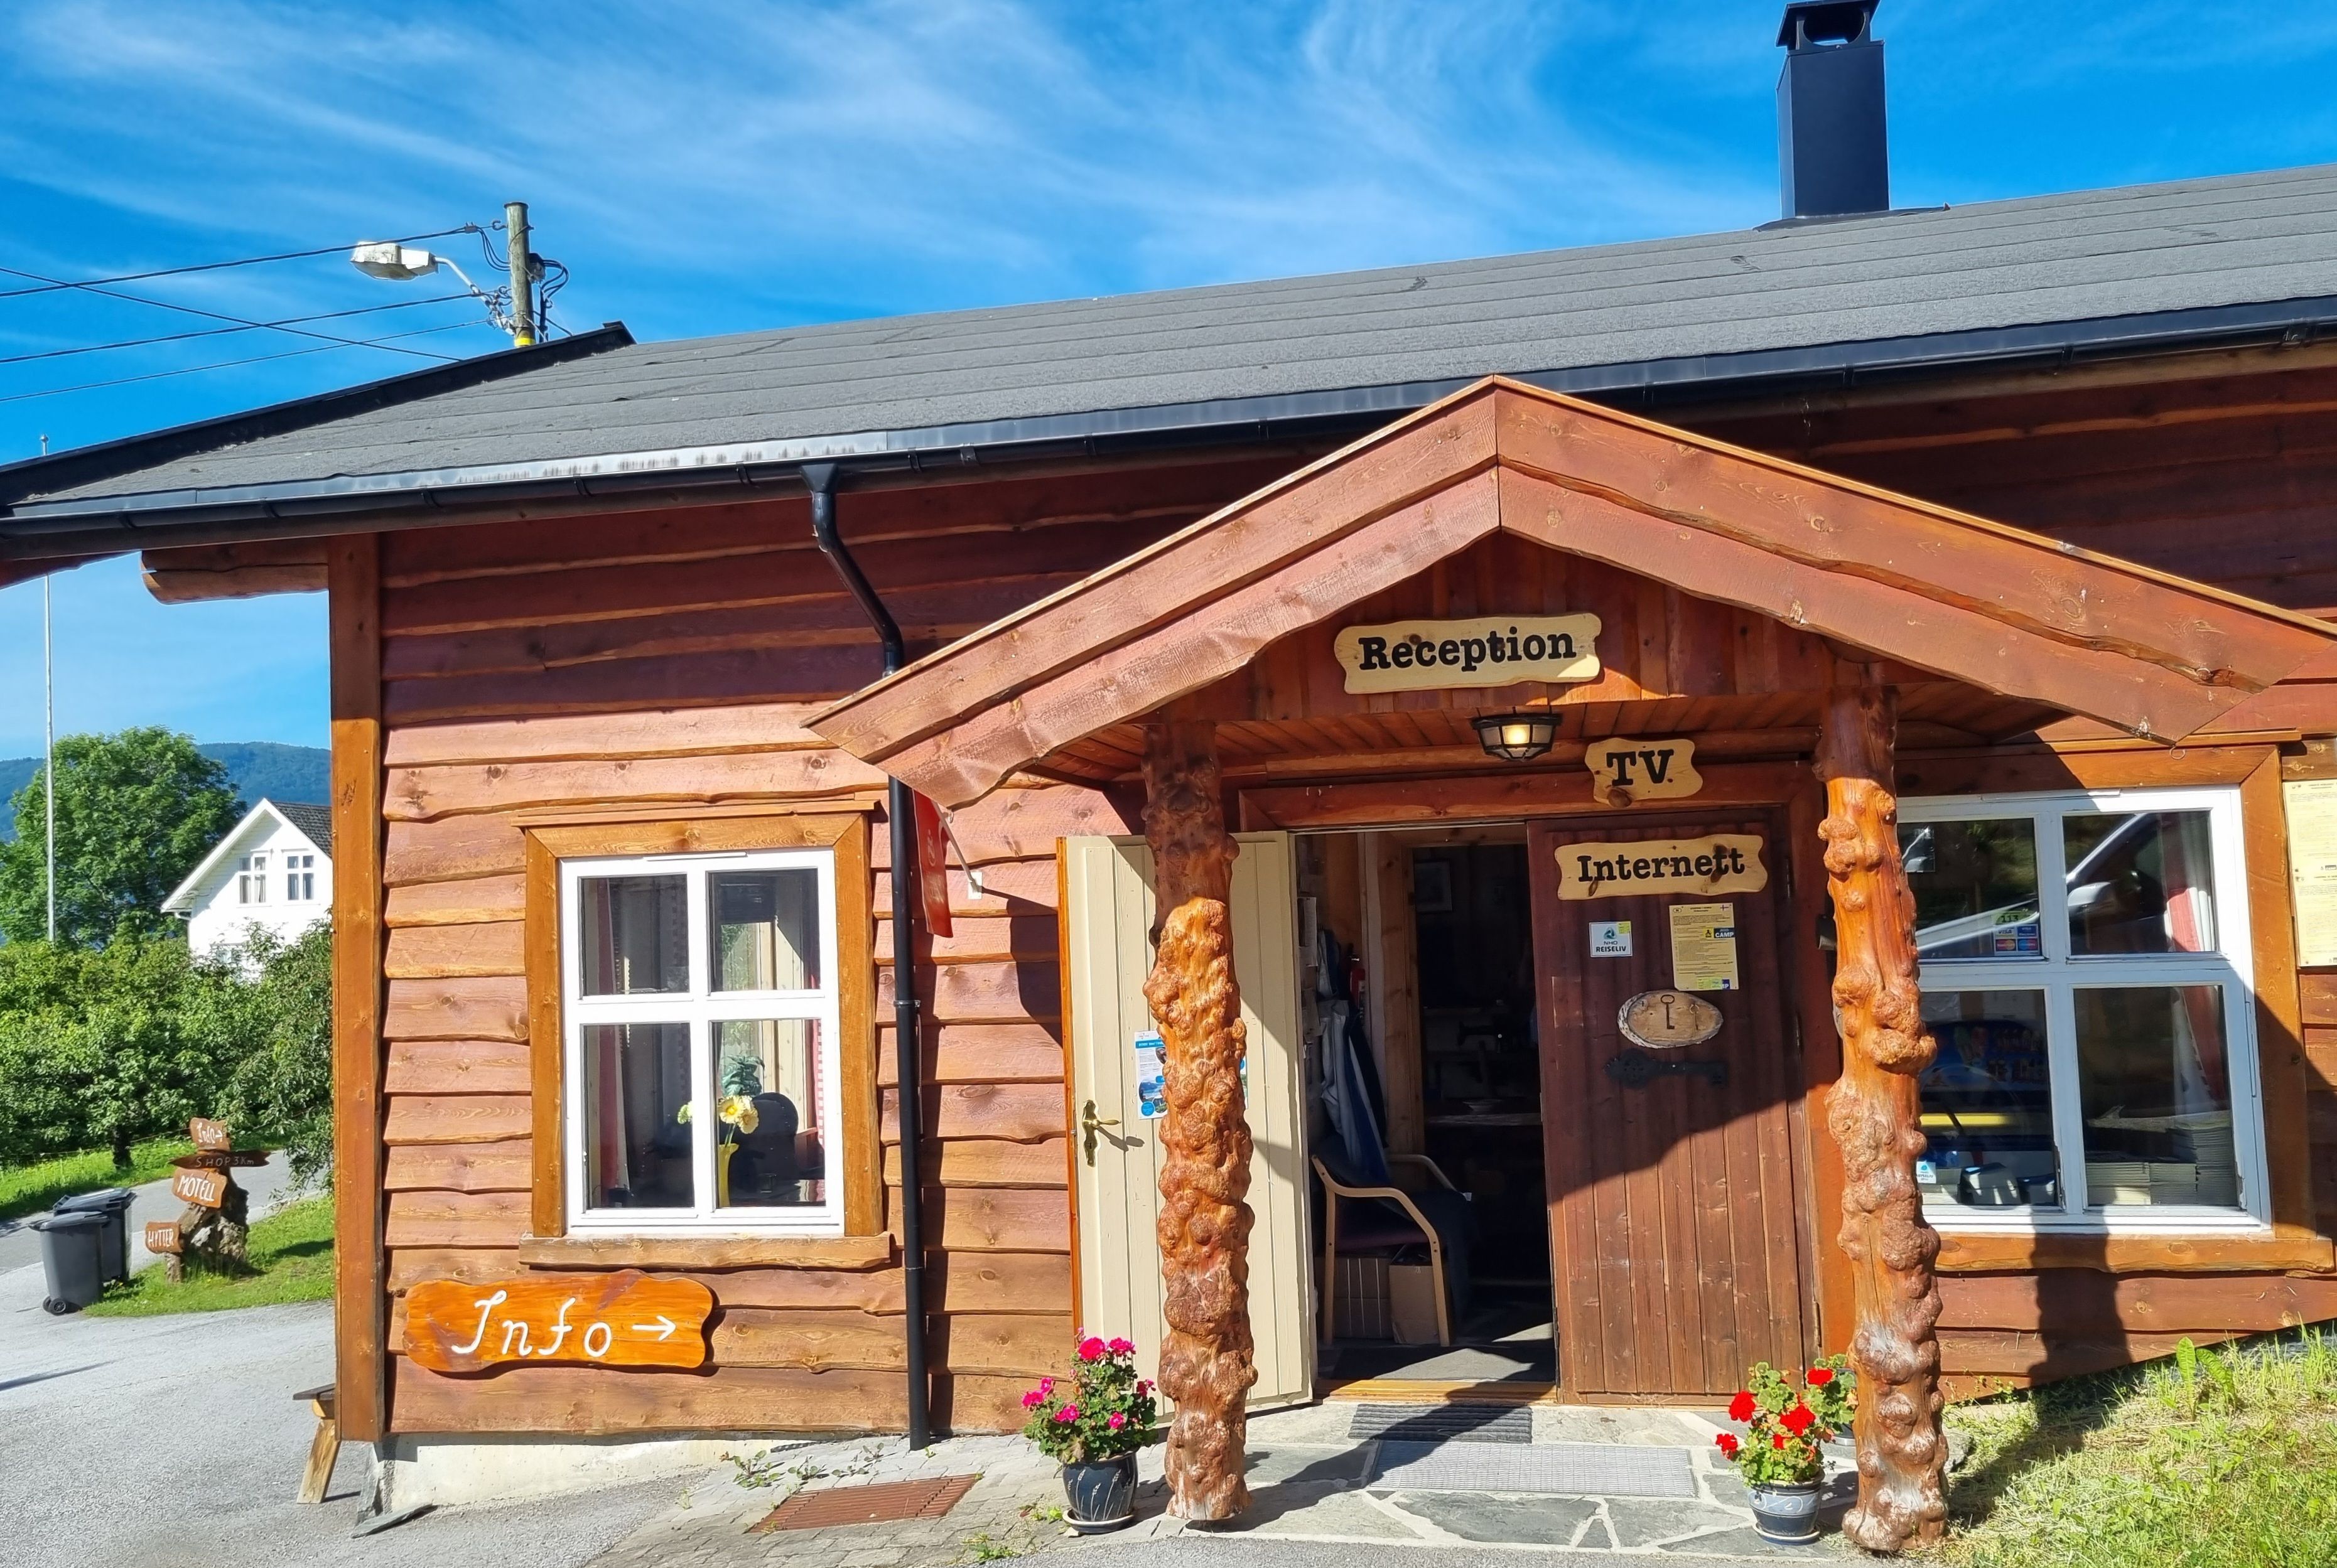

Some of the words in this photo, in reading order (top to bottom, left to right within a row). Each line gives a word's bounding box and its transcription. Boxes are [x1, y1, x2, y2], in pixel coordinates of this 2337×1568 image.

[1358, 626, 1577, 672] Reception
[1606, 749, 1674, 786] TV
[1577, 847, 1745, 883] Internett
[195, 1157, 230, 1168] SHOP
[177, 1174, 216, 1201] MOTELL
[148, 1228, 174, 1247] HYTTER
[451, 1290, 613, 1358] Info
